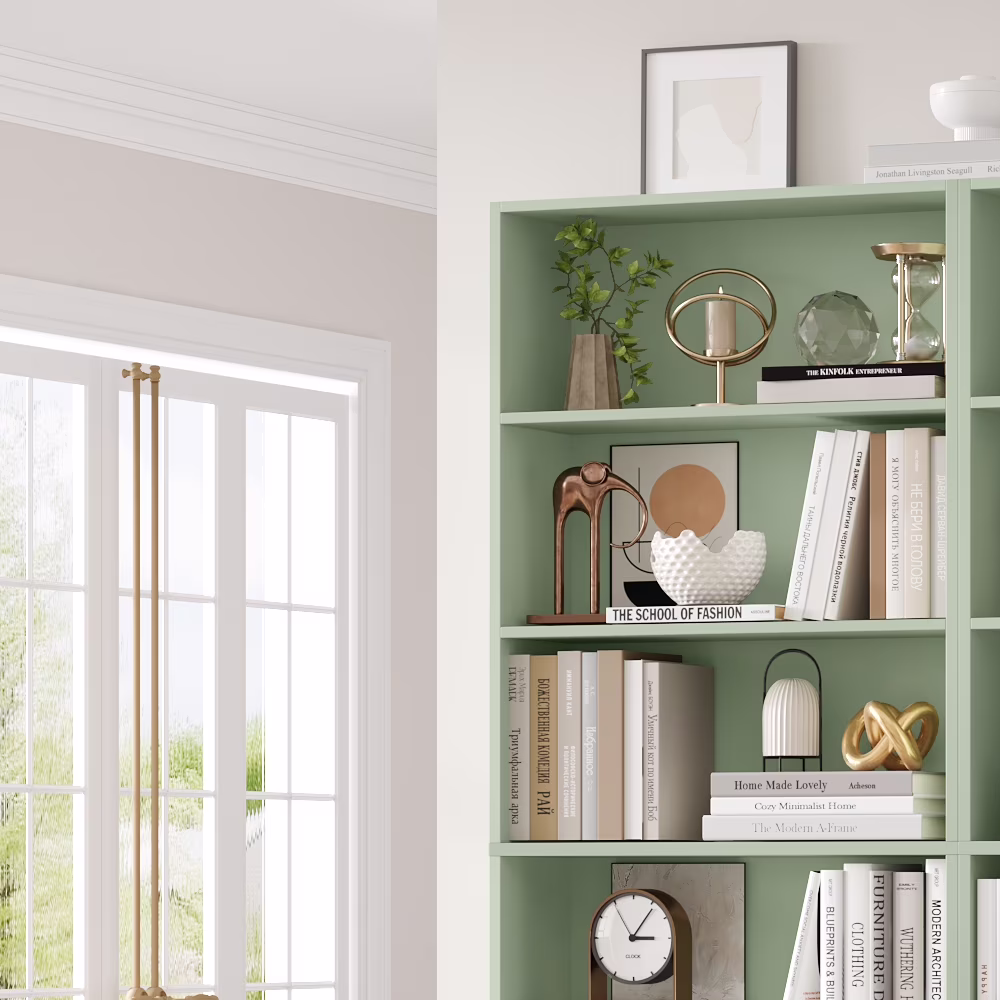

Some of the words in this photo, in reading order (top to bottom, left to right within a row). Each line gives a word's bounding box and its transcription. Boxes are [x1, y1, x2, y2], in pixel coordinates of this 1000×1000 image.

[875, 169, 906, 179] Jonathan
[908, 168, 945, 178] Livingston
[946, 166, 973, 176] Seagull
[819, 367, 854, 376] KINFOLK
[855, 367, 903, 375] ENTREPRENEUR
[910, 483, 923, 498] НЕ
[843, 496, 856, 529] Религия
[910, 502, 923, 533] БЕРИ
[838, 531, 848, 559] черной
[830, 561, 843, 603] водолазки
[910, 545, 923, 592] ГОЛОВУ
[612, 609, 633, 621] THE
[635, 608, 677, 621] SCHOOL
[680, 607, 694, 620] OF
[697, 606, 742, 620] FASHION
[508, 728, 522, 800] Триумфальная
[537, 745, 550, 784] КОМЕДИЯ
[734, 780, 763, 791] Home
[765, 780, 793, 790] Made
[795, 780, 828, 793] Lovely
[848, 782, 876, 790] Acheson
[508, 803, 519, 825] арка
[537, 791, 555, 815] РАЙ
[754, 802, 776, 812] Cozy
[778, 801, 825, 810] Minimalist
[828, 801, 857, 810] Home
[826, 906, 835, 968] BLUEPRINTS
[873, 874, 885, 984] FURNITURE
[931, 900, 942, 945] MODERN
[851, 922, 865, 988] CLOTHING
[900, 927, 914, 991] WUTHERING
